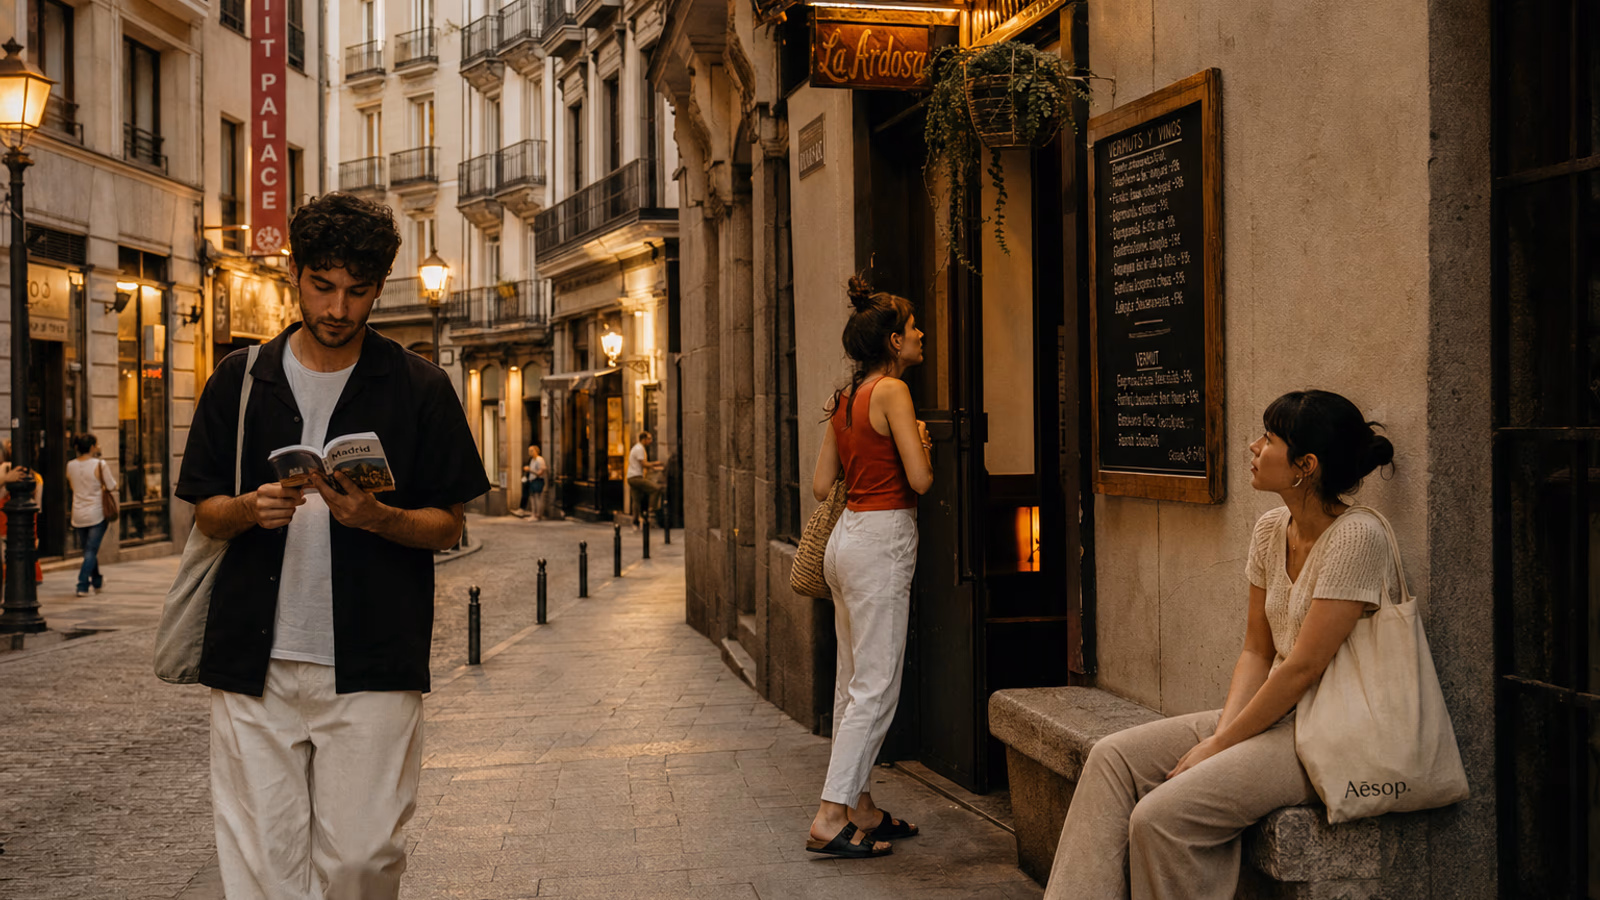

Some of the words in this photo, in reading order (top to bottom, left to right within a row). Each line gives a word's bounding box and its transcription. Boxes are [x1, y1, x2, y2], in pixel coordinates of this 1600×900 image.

[818, 27, 848, 83] La
[848, 28, 927, 80] Ardosa
[260, 73, 278, 209] PALACE
[1107, 132, 1143, 158] VERMUTS
[1147, 128, 1153, 145] Y
[1158, 119, 1182, 141] VINOS
[1135, 350, 1159, 367] VERMUT
[331, 445, 371, 461] Madrid
[1344, 780, 1411, 799] Aēsop.
